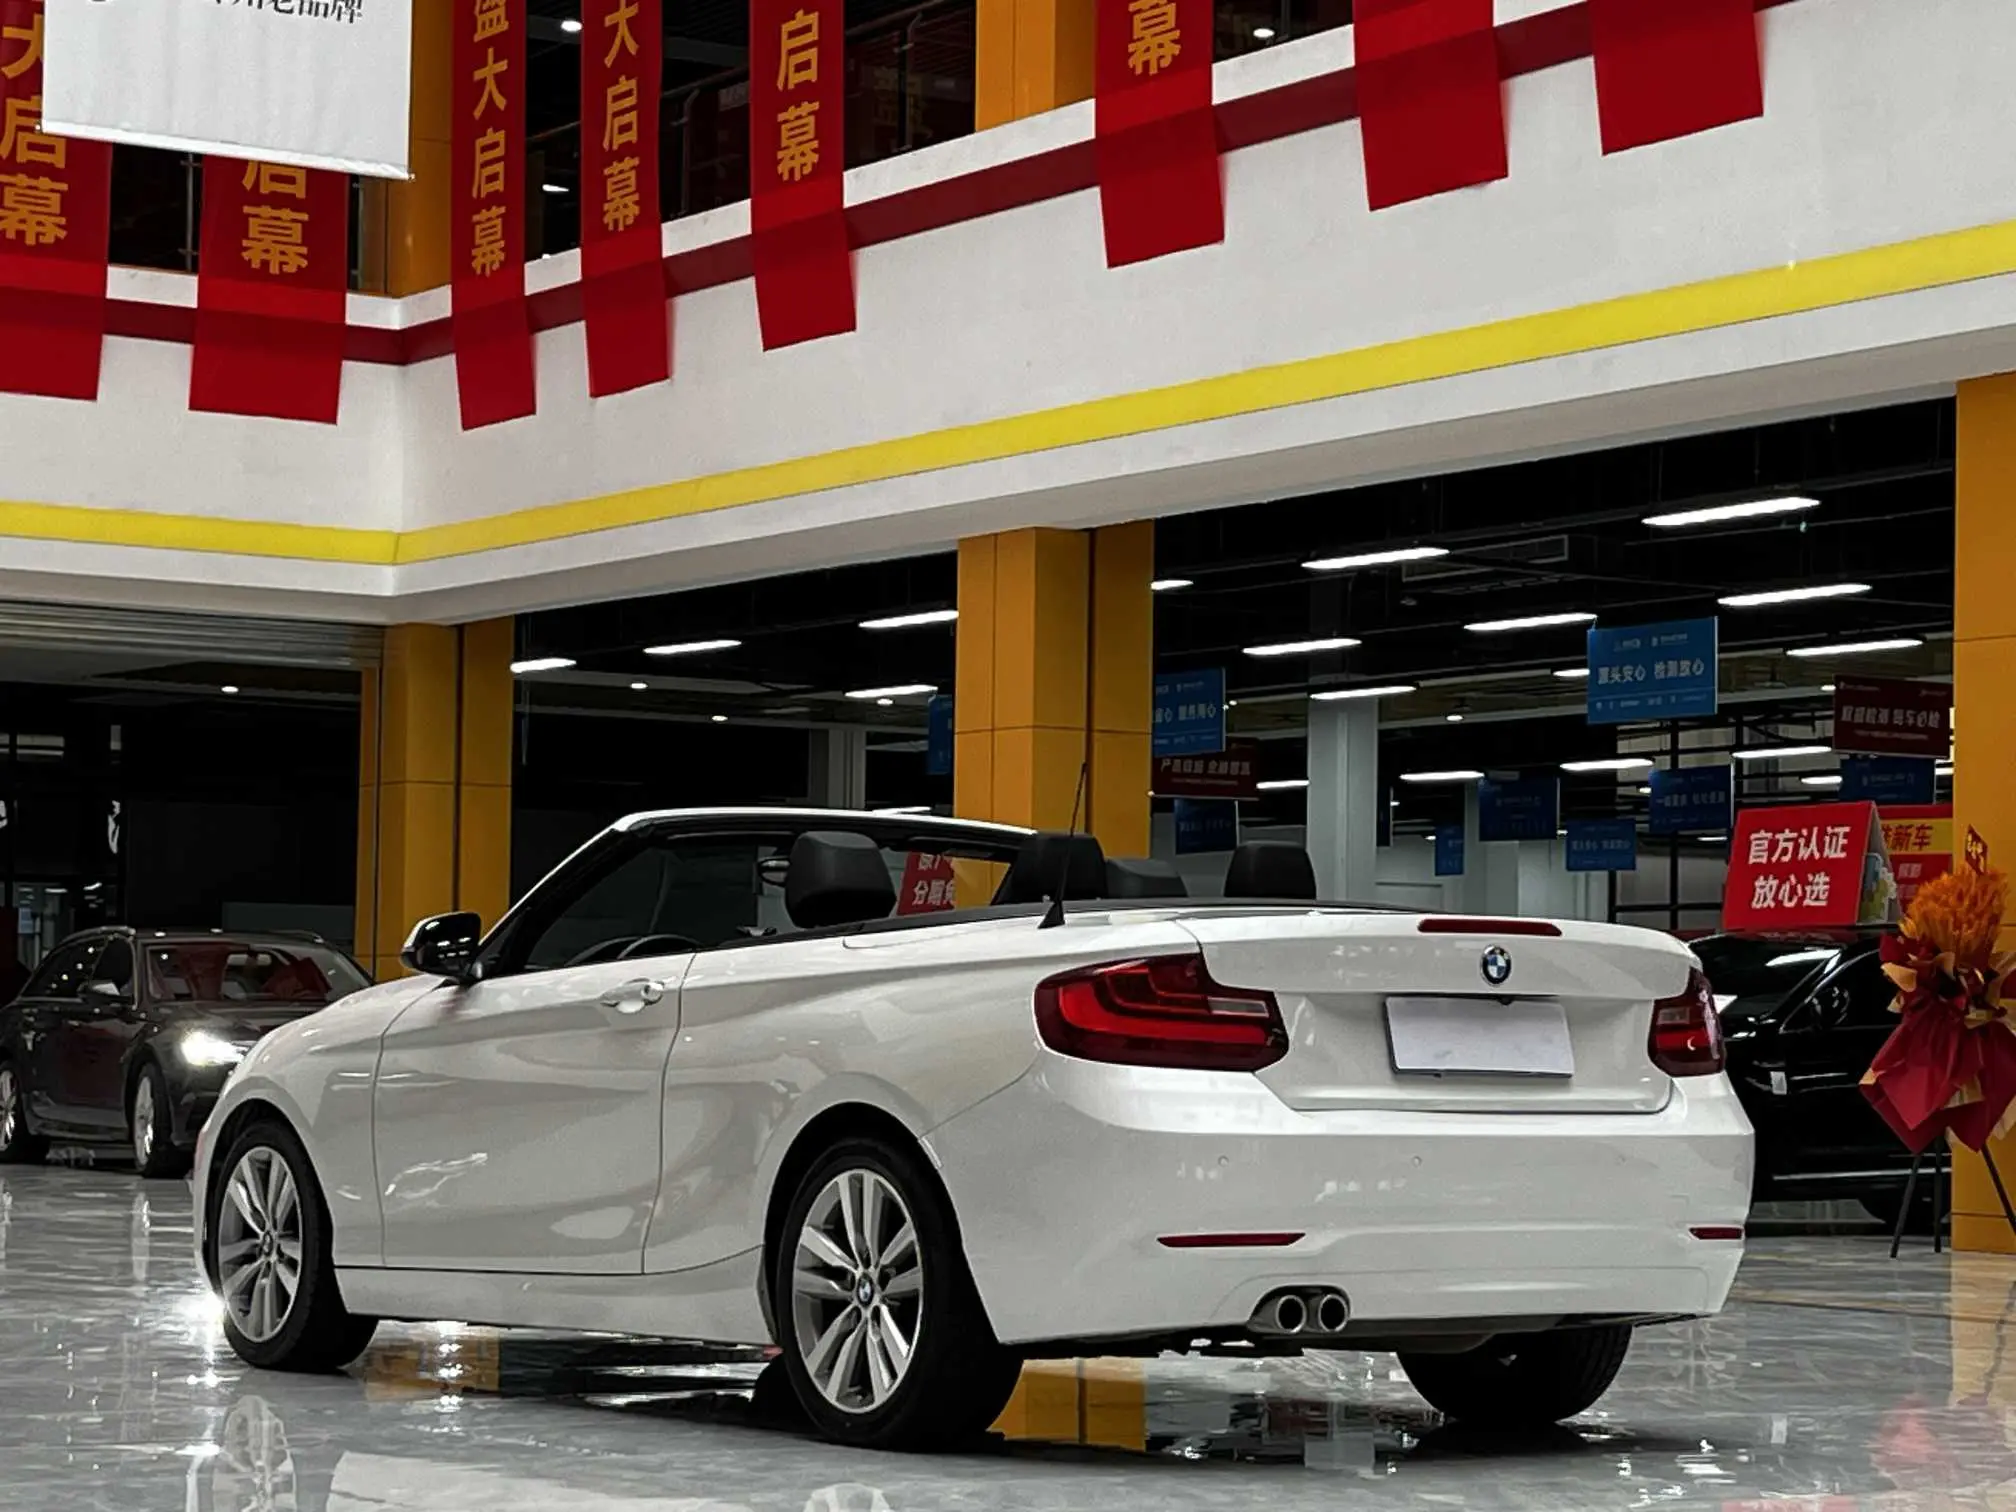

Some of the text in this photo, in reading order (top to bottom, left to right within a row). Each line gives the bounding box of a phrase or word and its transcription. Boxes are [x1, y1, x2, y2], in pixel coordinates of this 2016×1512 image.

[1127, 0, 1182, 75] 幕
[603, 0, 641, 232] 大启幕
[777, 9, 820, 181] 启幕
[1748, 826, 1852, 866] 官方认证
[1752, 871, 1830, 910] 放心选
